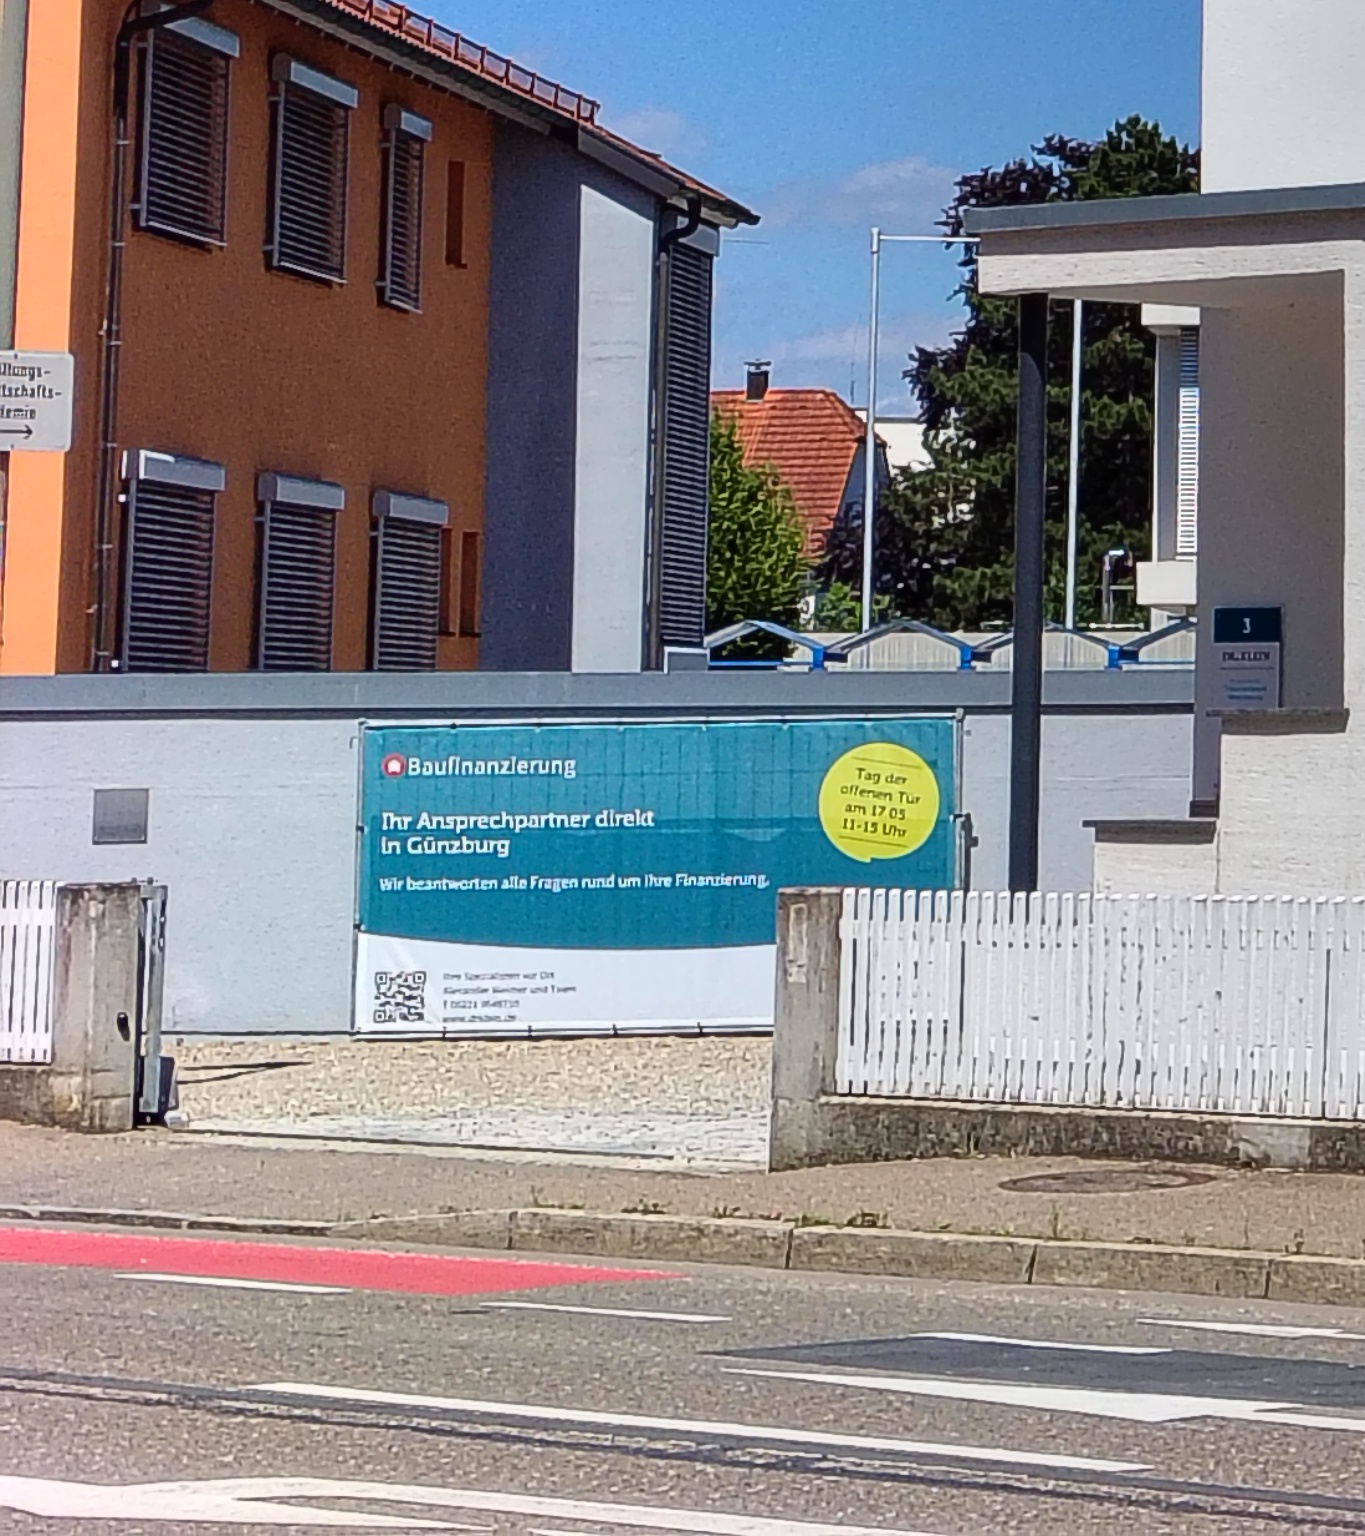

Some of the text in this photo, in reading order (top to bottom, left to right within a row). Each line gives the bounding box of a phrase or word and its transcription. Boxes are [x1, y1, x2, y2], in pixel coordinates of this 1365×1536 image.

[407, 756, 577, 779] Baufinanzierung
[856, 767, 907, 785] Tag der
[840, 784, 921, 805] offenen Tür
[845, 803, 866, 816] am
[381, 809, 655, 834] Ihr Ansprechpartner direkt
[842, 818, 907, 838] 11-15 Uhr
[381, 836, 510, 858] in Günzburg
[379, 878, 404, 891] Wir
[406, 876, 498, 891] beantworten
[500, 876, 527, 890] alle
[530, 875, 579, 893] Fragen
[582, 873, 615, 889] rund
[618, 875, 641, 888] um
[644, 874, 673, 888] Ihre
